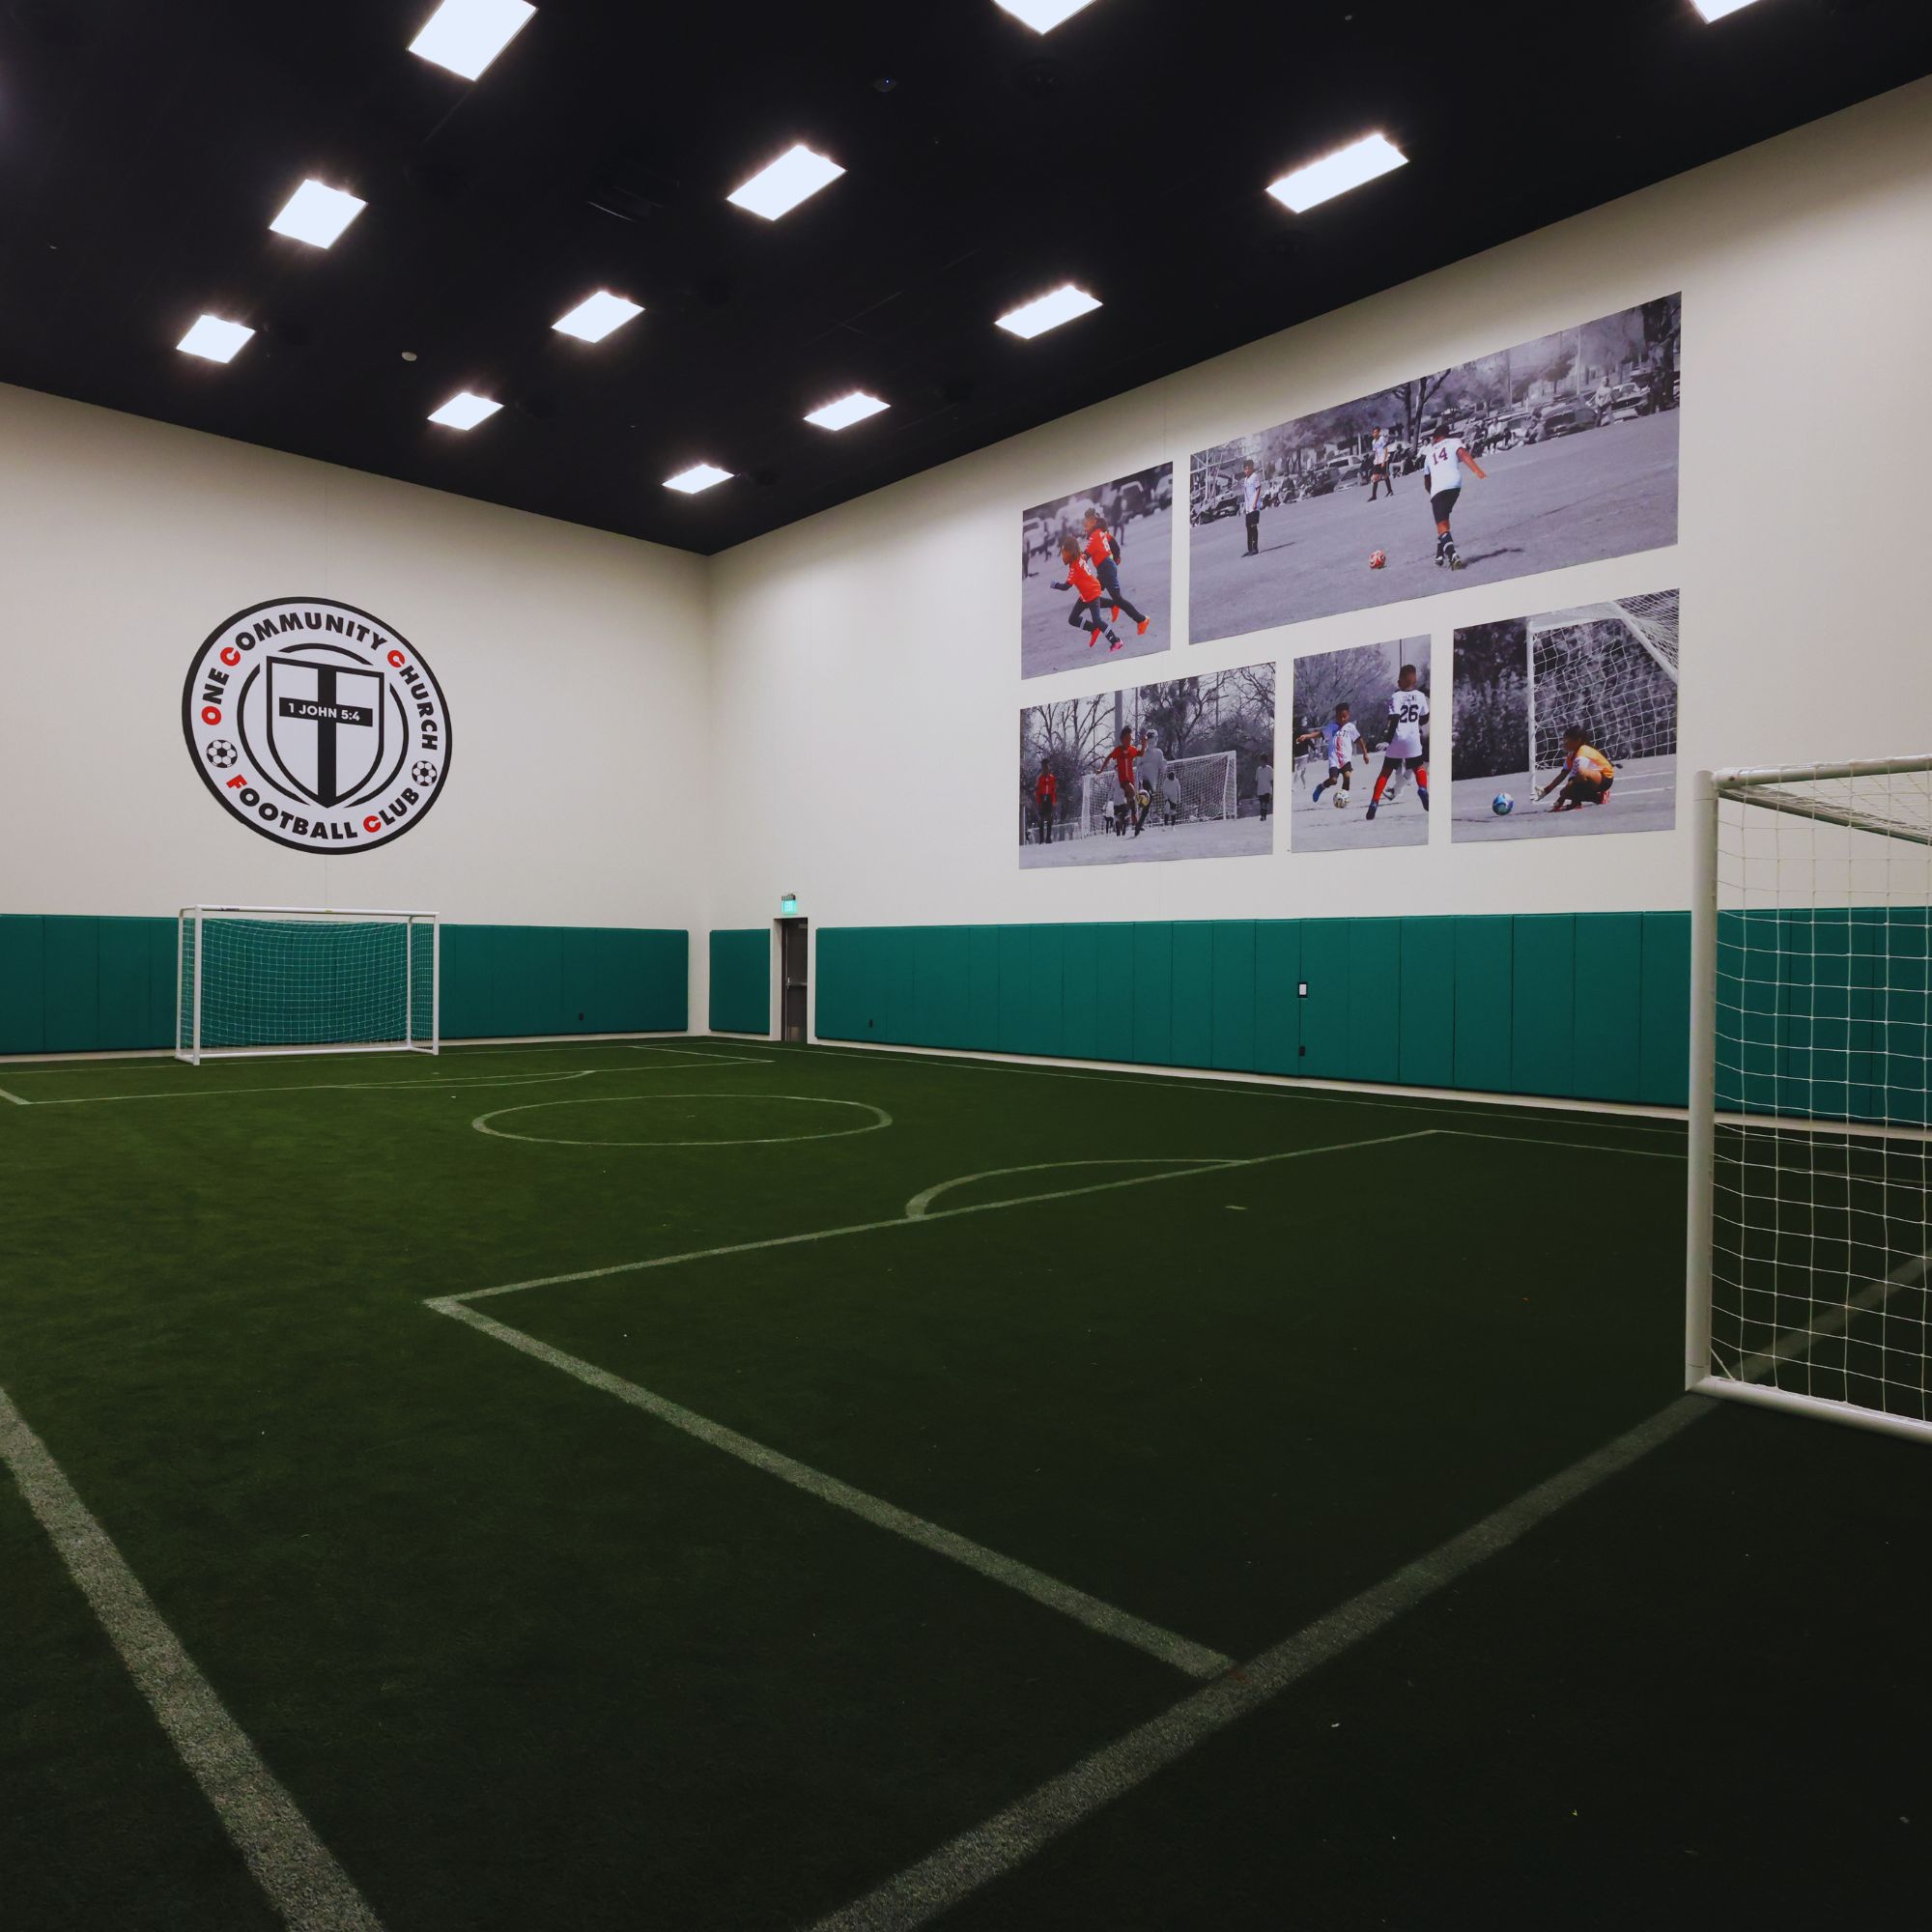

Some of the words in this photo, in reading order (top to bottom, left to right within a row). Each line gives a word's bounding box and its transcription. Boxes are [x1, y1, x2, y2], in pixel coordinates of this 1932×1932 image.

[1433, 447, 1448, 465] 14
[201, 668, 229, 726] ONE
[220, 611, 387, 667] COMMUNITY
[387, 649, 439, 751] CHURCH
[288, 702, 295, 714] 1
[298, 704, 337, 719] JOHN
[341, 709, 360, 722] 5:4
[1399, 704, 1418, 723] 26
[226, 774, 358, 839] FOOTBALL
[362, 787, 420, 834] CLUB
